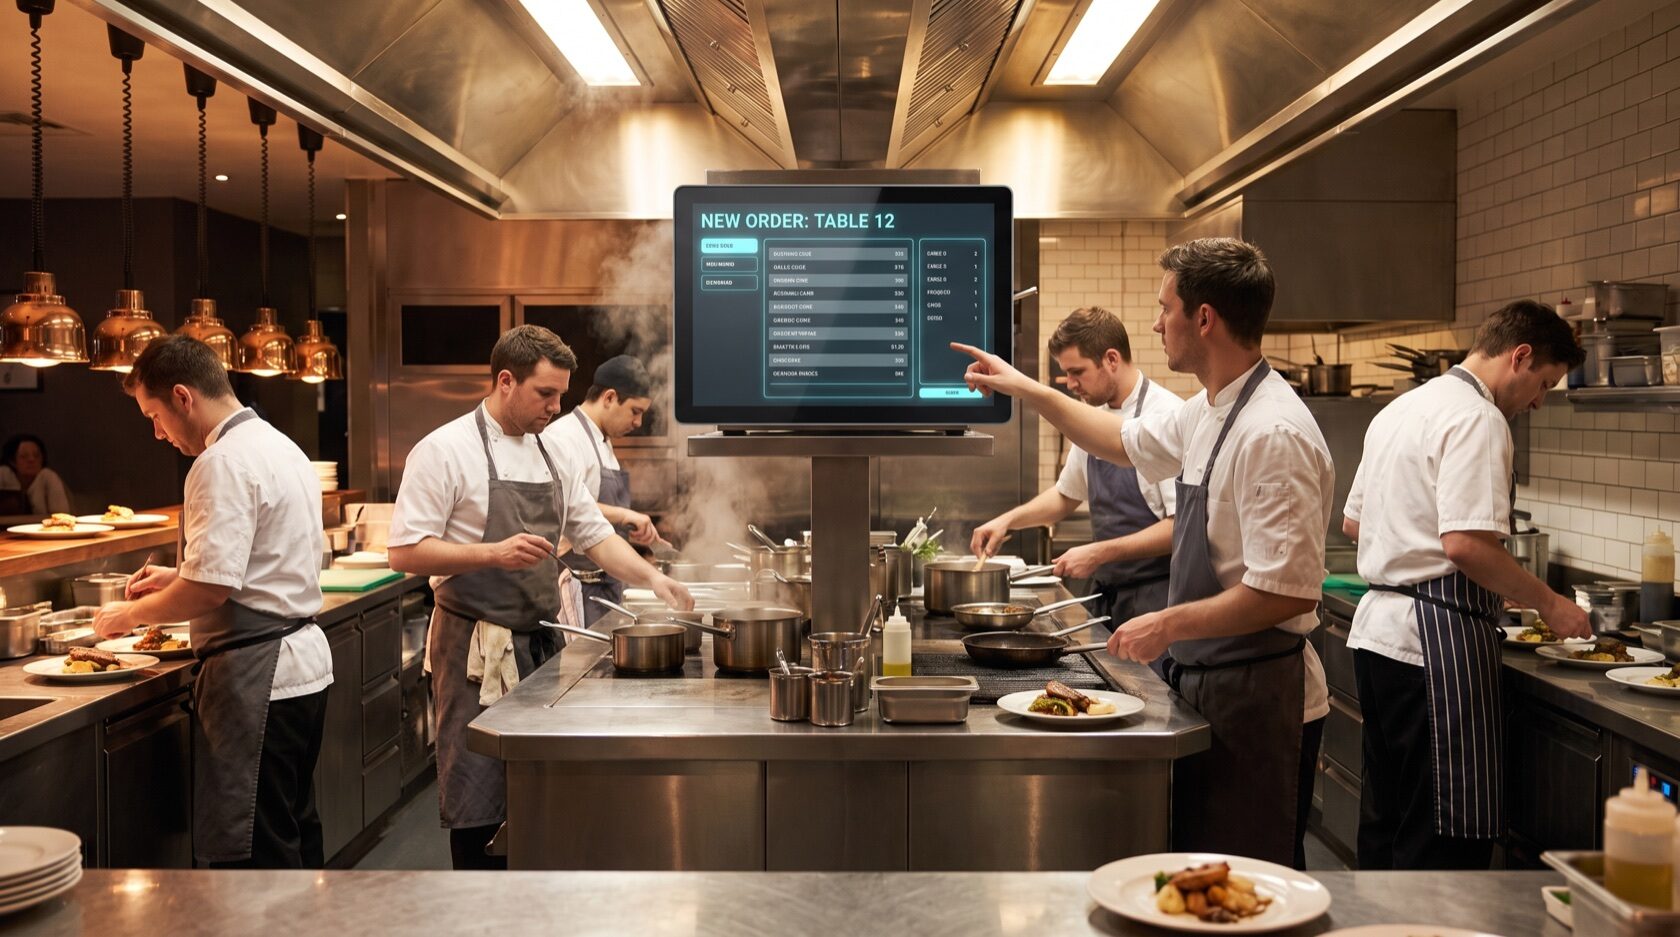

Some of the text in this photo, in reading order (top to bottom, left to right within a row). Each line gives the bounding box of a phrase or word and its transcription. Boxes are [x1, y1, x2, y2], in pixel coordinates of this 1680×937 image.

[701, 213, 895, 229] NEW ORDER: TABLE 12
